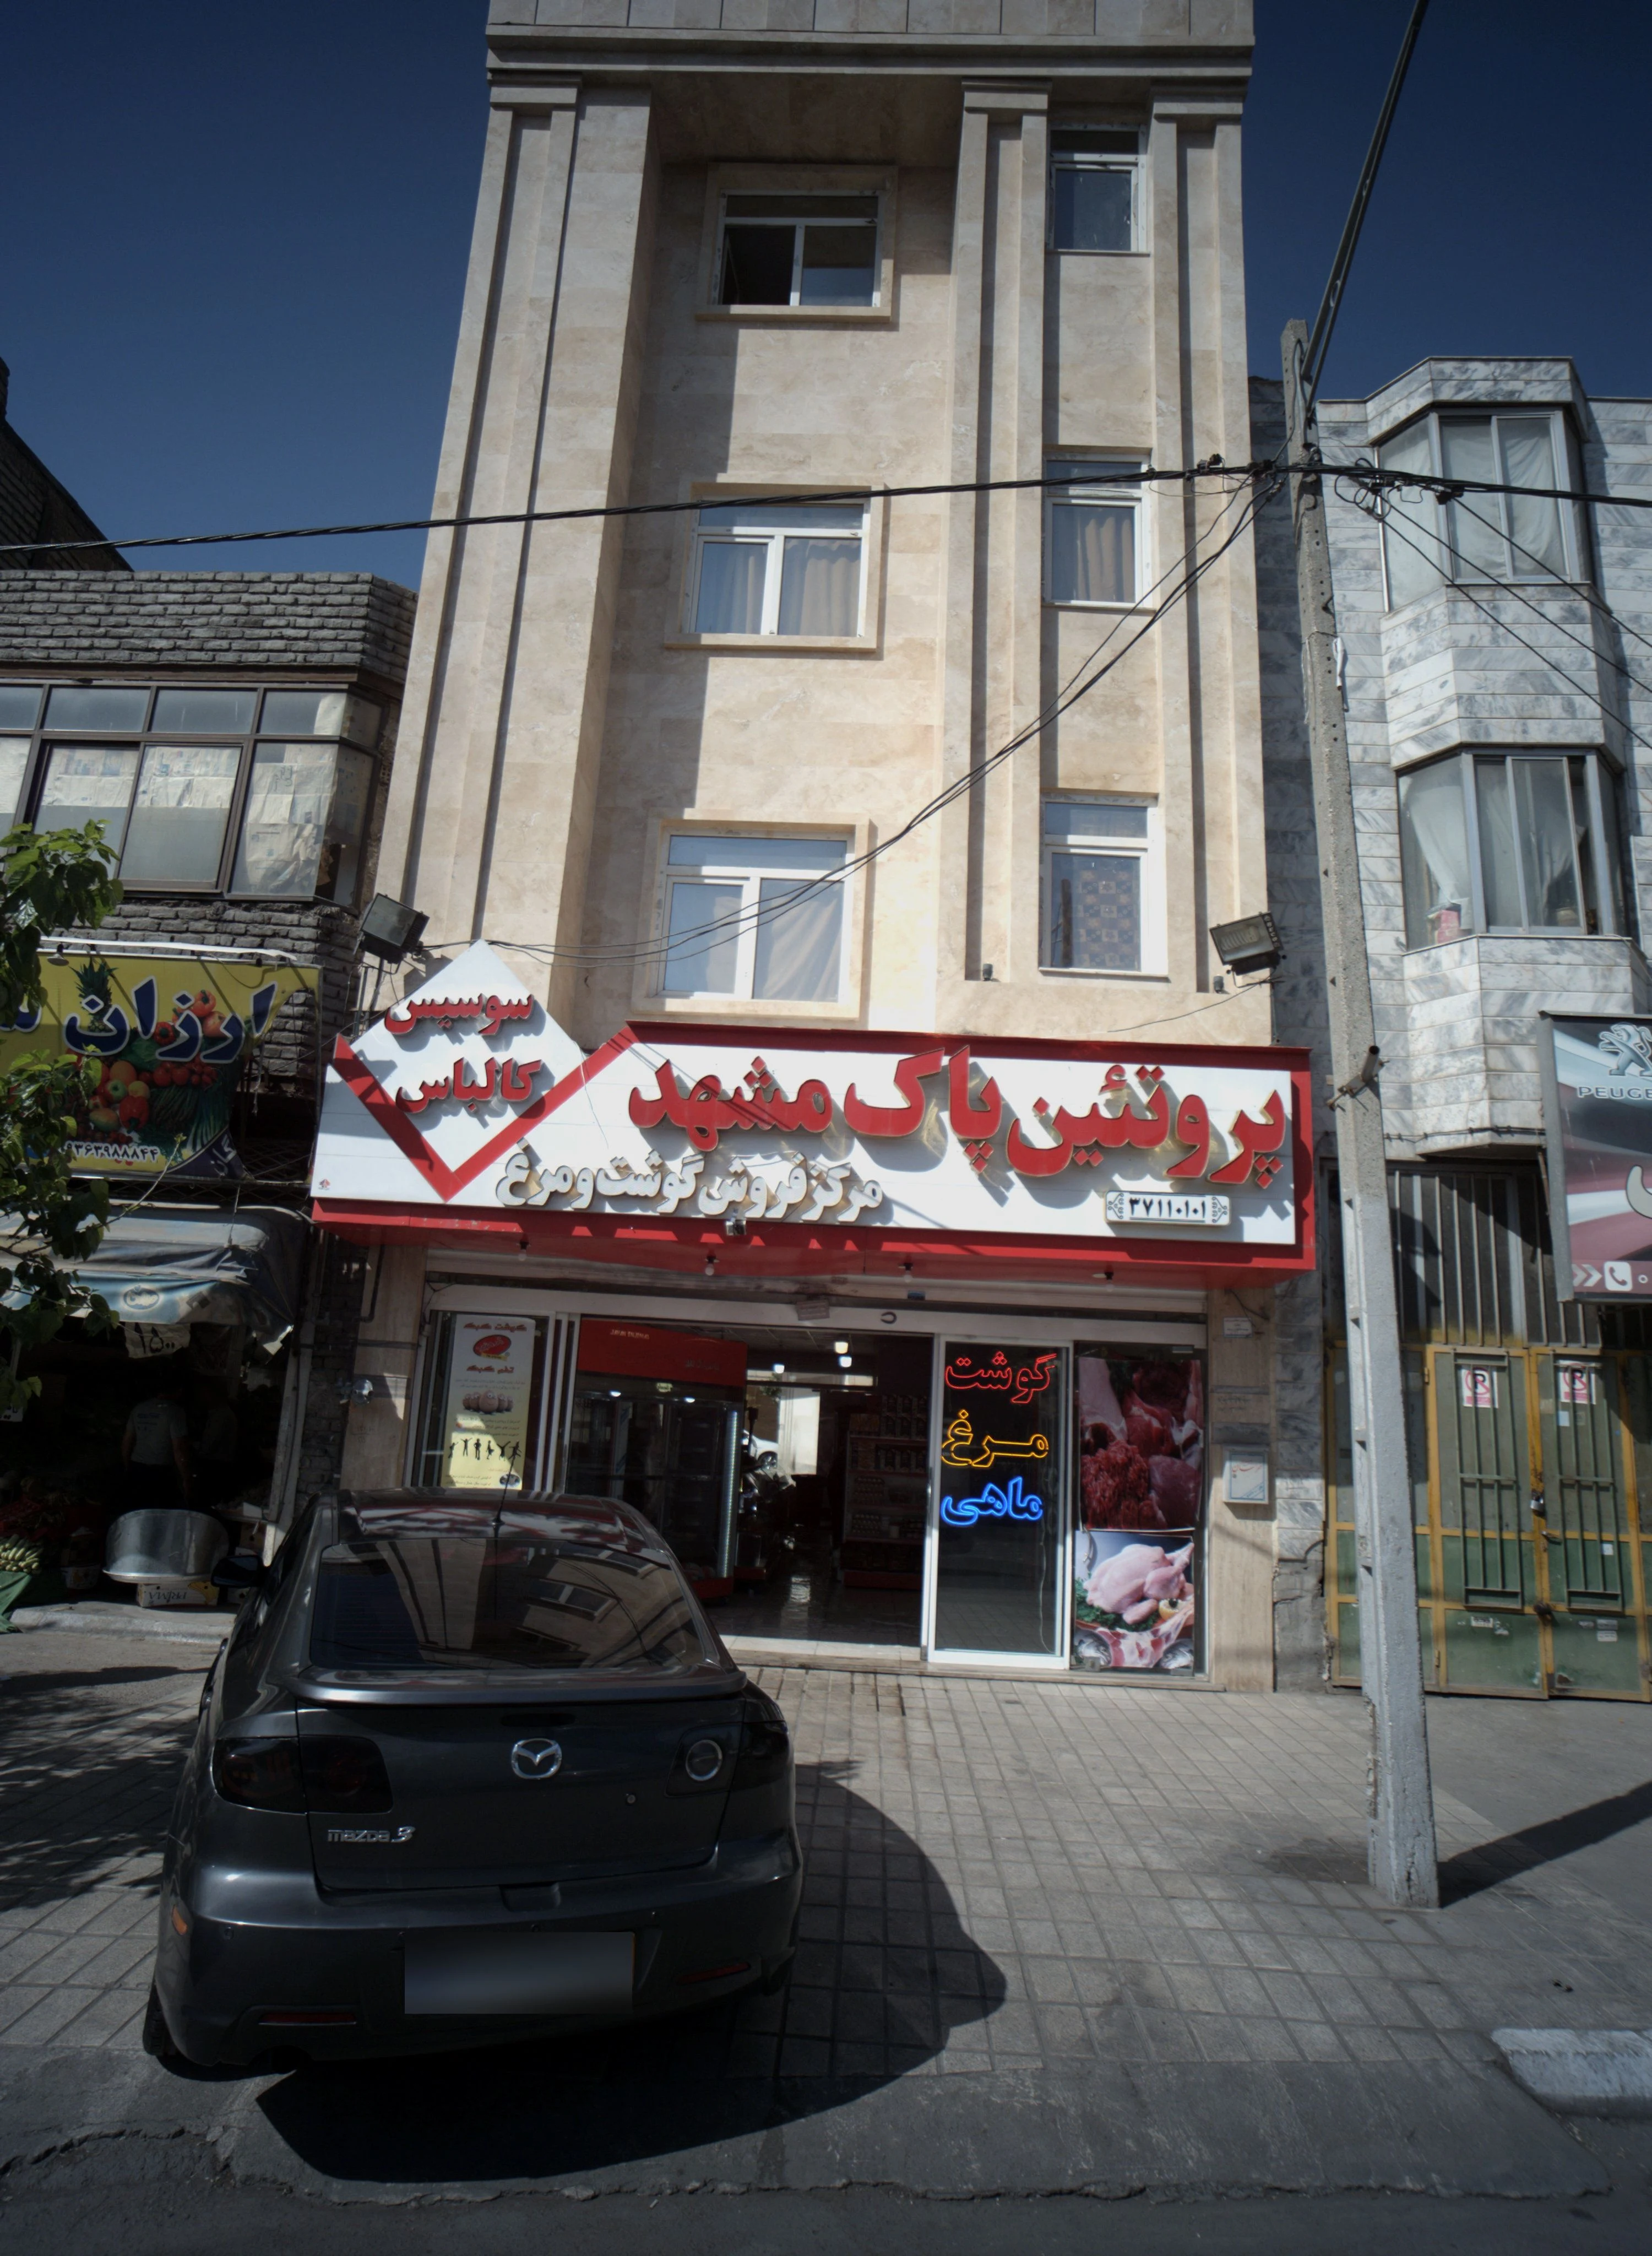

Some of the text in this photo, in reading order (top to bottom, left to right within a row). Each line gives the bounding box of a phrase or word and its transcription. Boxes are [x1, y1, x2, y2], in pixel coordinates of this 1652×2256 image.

[63, 975, 278, 1064] ارزان
[384, 993, 534, 1035] سوسیس
[395, 1057, 544, 1114] کالباس
[628, 1045, 1285, 1189] پروتئین پاک مشهد
[496, 1136, 883, 1222] مرکز فروش گوشت و مرغ
[1129, 1197, 1206, 1218] ۳۷۱۱۰۱۰۱
[945, 1350, 1057, 1404] گوشت
[941, 1409, 1049, 1468] مرغ
[941, 1476, 1044, 1526] ماهی
